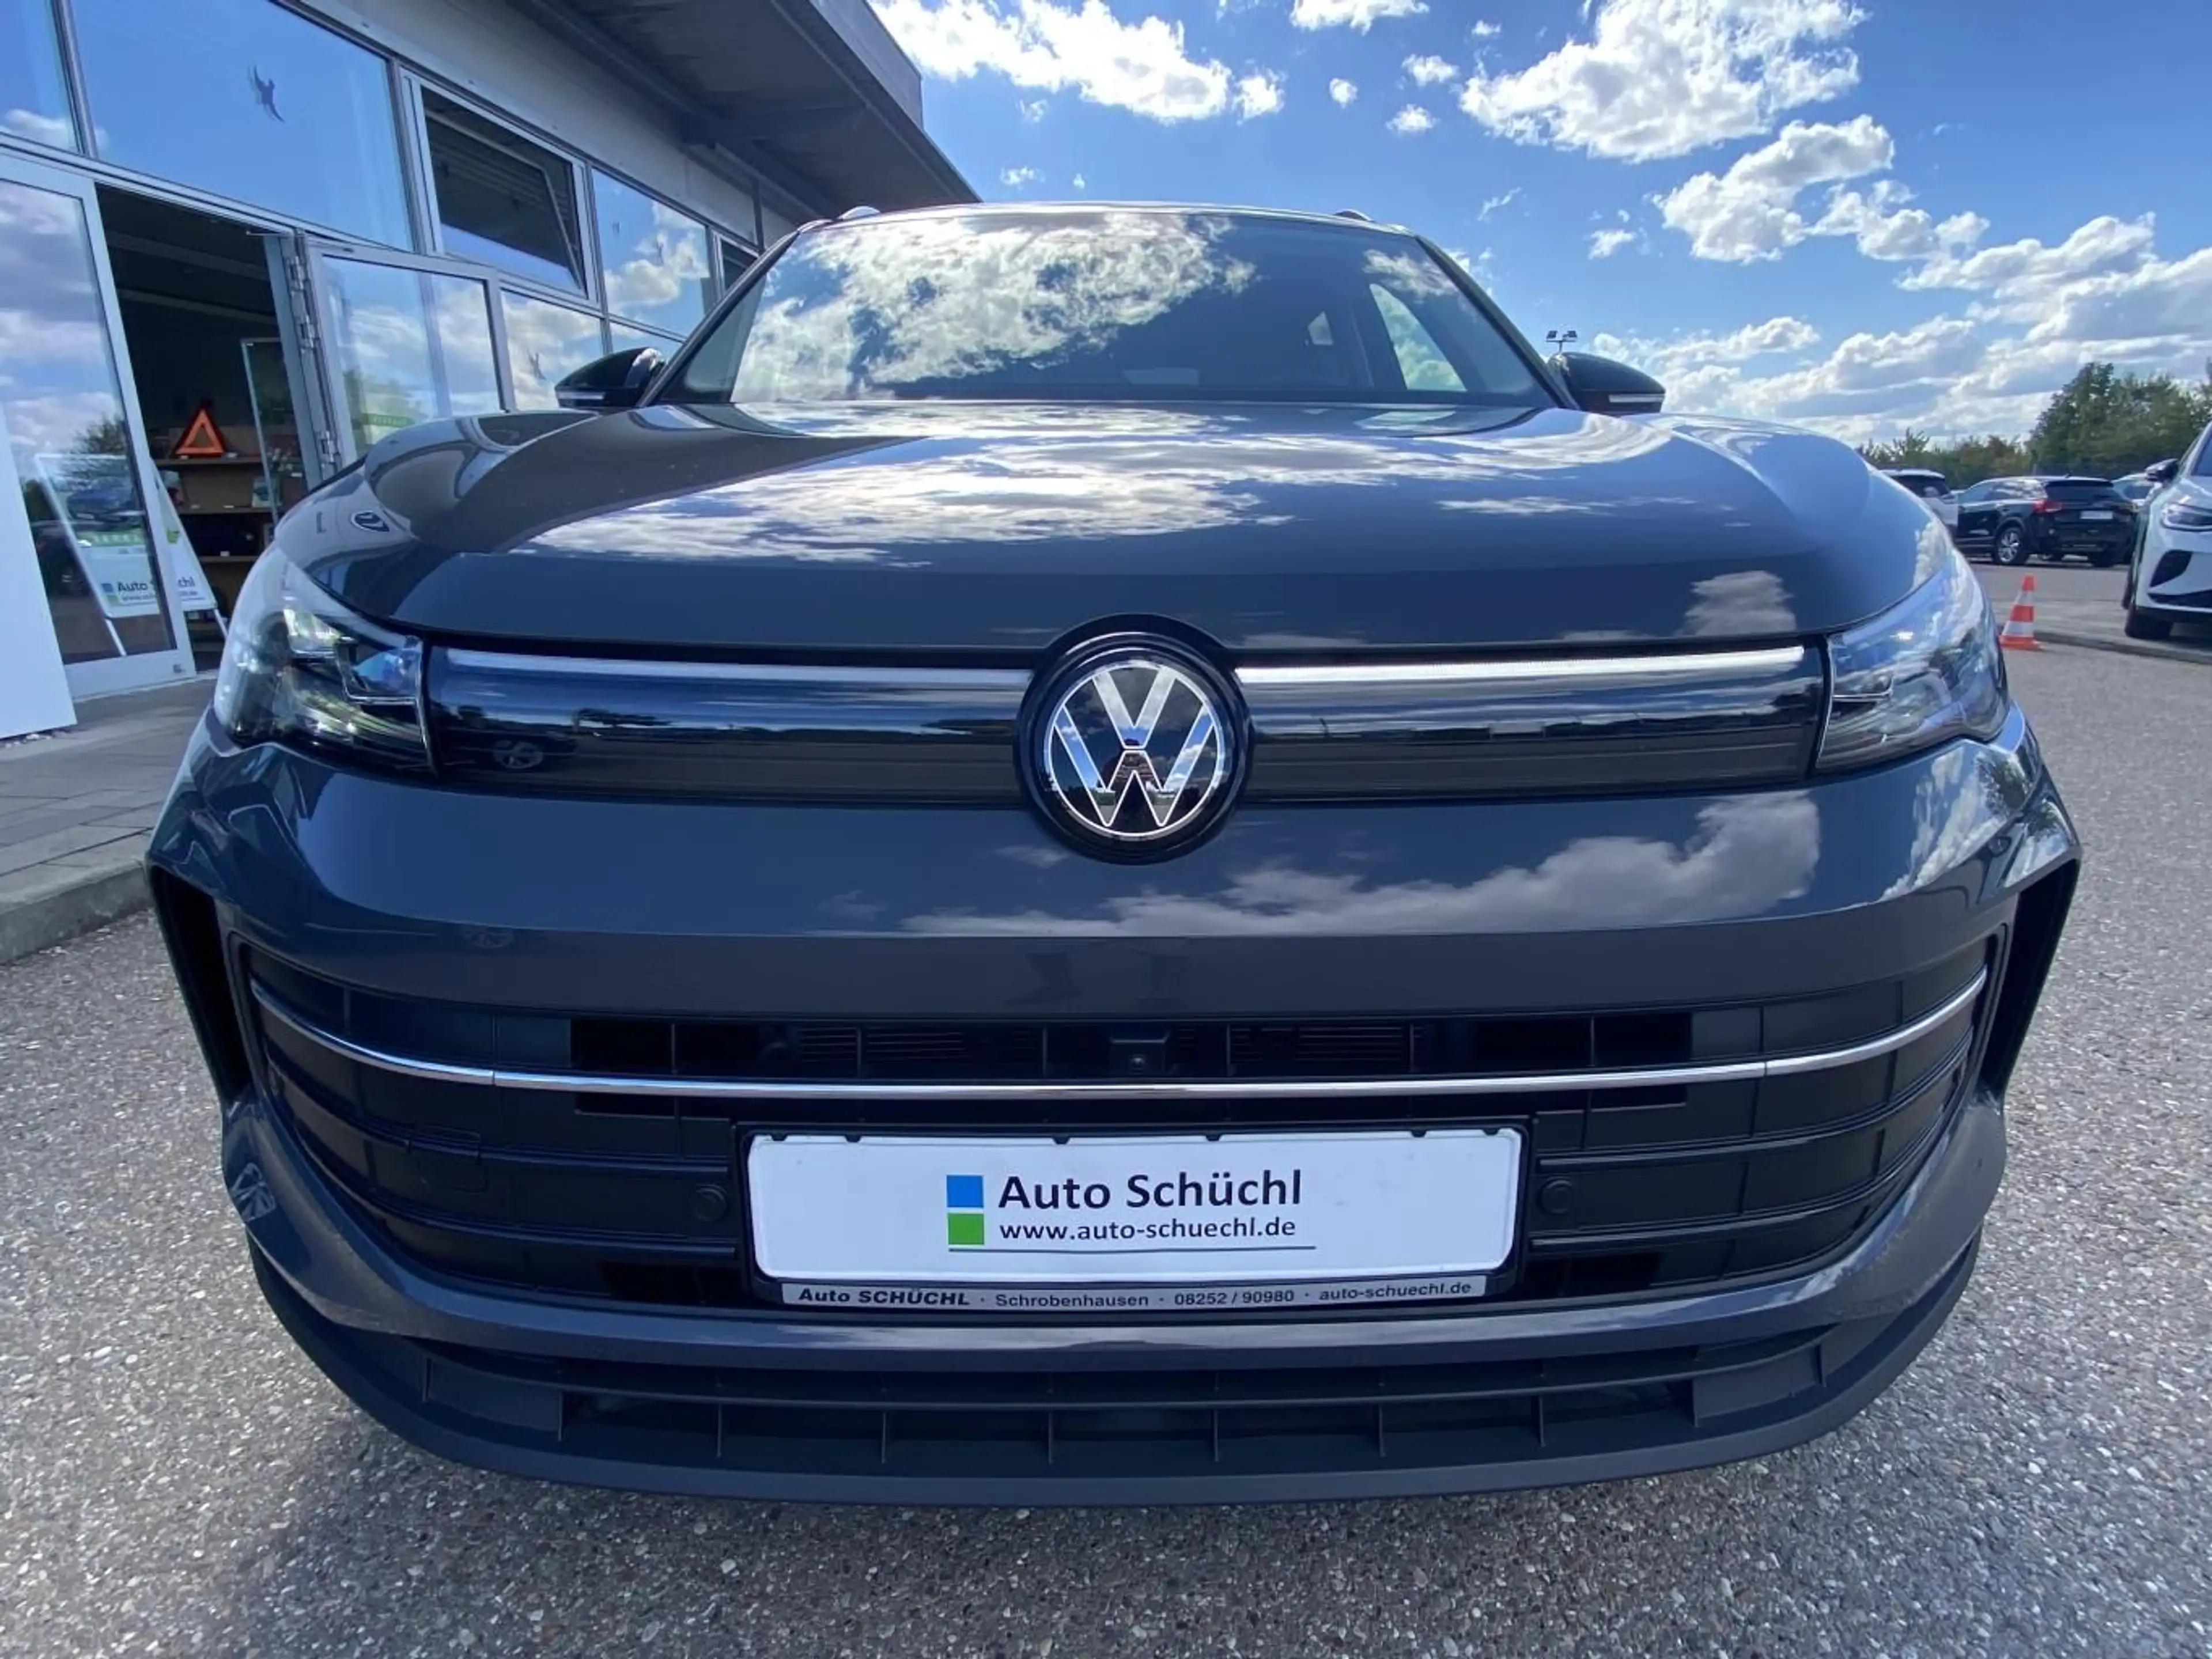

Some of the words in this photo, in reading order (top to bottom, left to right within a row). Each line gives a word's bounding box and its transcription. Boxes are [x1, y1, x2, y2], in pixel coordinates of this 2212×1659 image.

[118, 582, 148, 592] Auto
[998, 1175, 1111, 1210] Auto
[1126, 1169, 1300, 1208] Schüchl
[1000, 1216, 1295, 1240] www.auto-schuechl.de
[798, 1287, 851, 1303] Auto
[857, 1286, 970, 1306] SCHÜCHL
[995, 1293, 1149, 1307] Schrobenhausen
[1174, 1292, 1228, 1306] 08252
[1242, 1290, 1295, 1304] 90980
[1318, 1282, 1472, 1301] auto-schuechl.de
